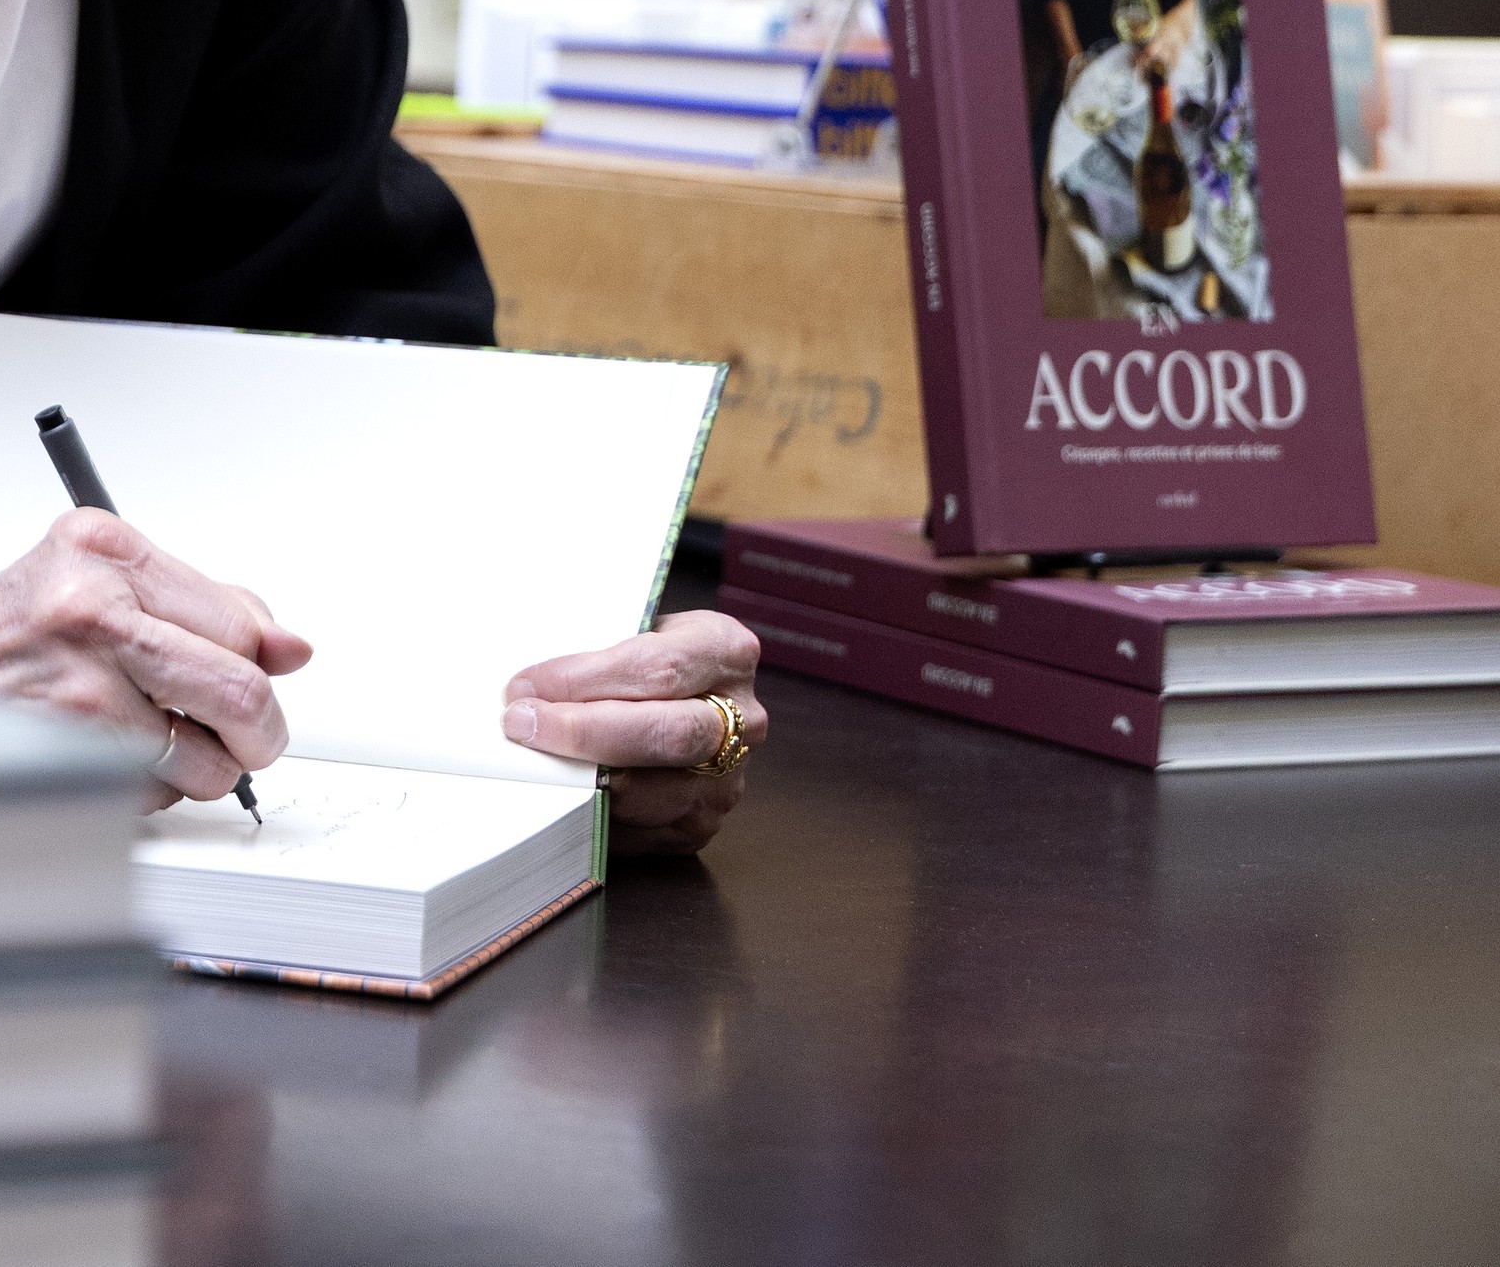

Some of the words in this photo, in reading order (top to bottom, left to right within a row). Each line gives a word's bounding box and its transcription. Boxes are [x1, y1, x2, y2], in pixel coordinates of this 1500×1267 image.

[1140, 301, 1182, 336] EN
[1024, 348, 1307, 432] ACCORD
[1114, 576, 1418, 603] ACCORD
